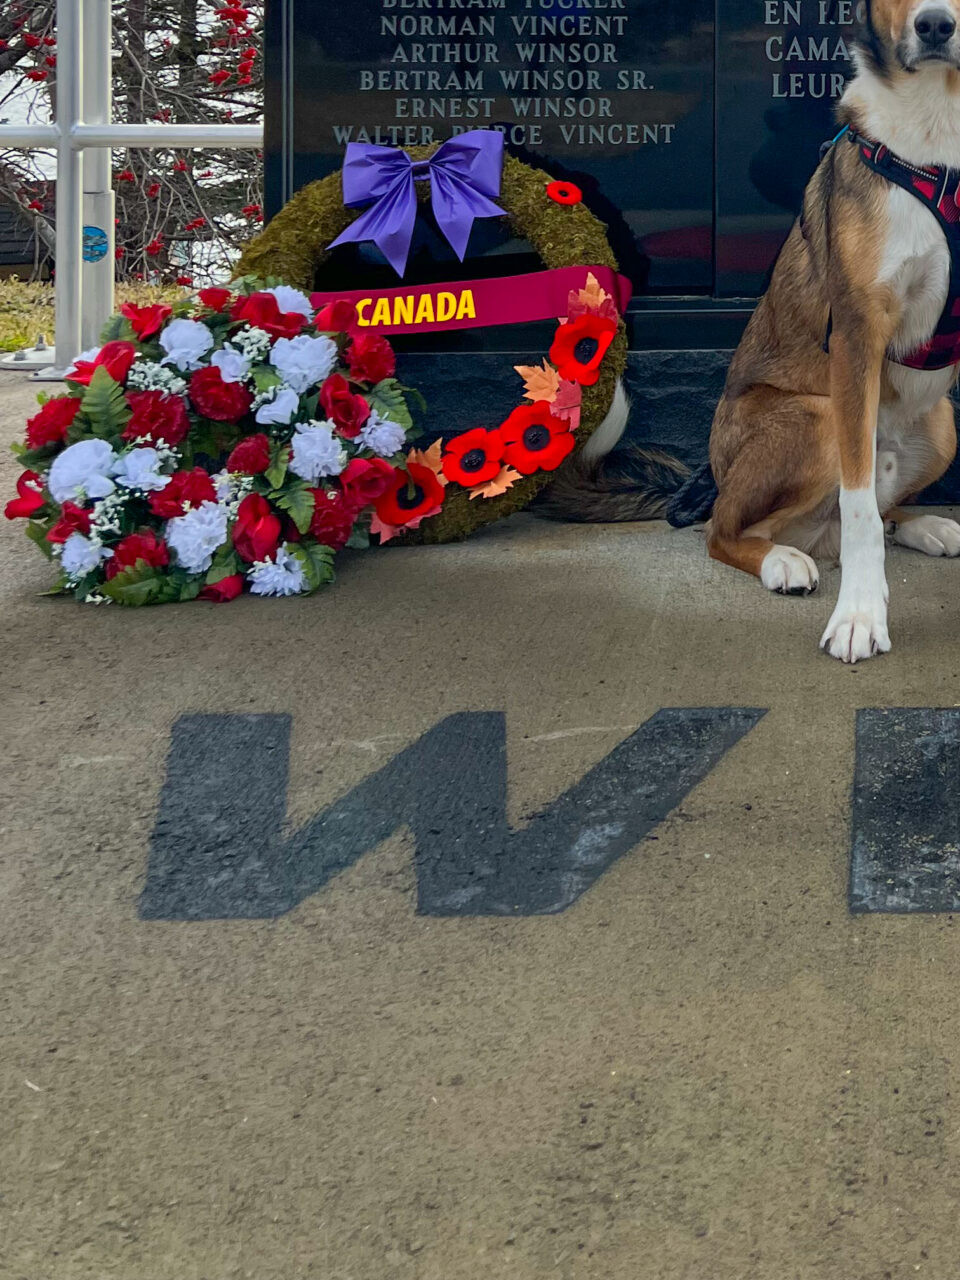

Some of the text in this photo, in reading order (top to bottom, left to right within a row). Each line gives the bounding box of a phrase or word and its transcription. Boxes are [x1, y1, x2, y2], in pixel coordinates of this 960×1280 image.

[763, 0, 802, 26] EN
[379, 15, 629, 37] NORMAN VINCENT
[390, 42, 618, 63] ARTHUR WINSOR
[359, 69, 655, 91] BERTRAM WINSOR SR.
[394, 97, 615, 119] ERNEST WINSOR
[331, 124, 434, 146] WALTER
[559, 124, 677, 145] VINCENT
[355, 289, 476, 327] CANADA
